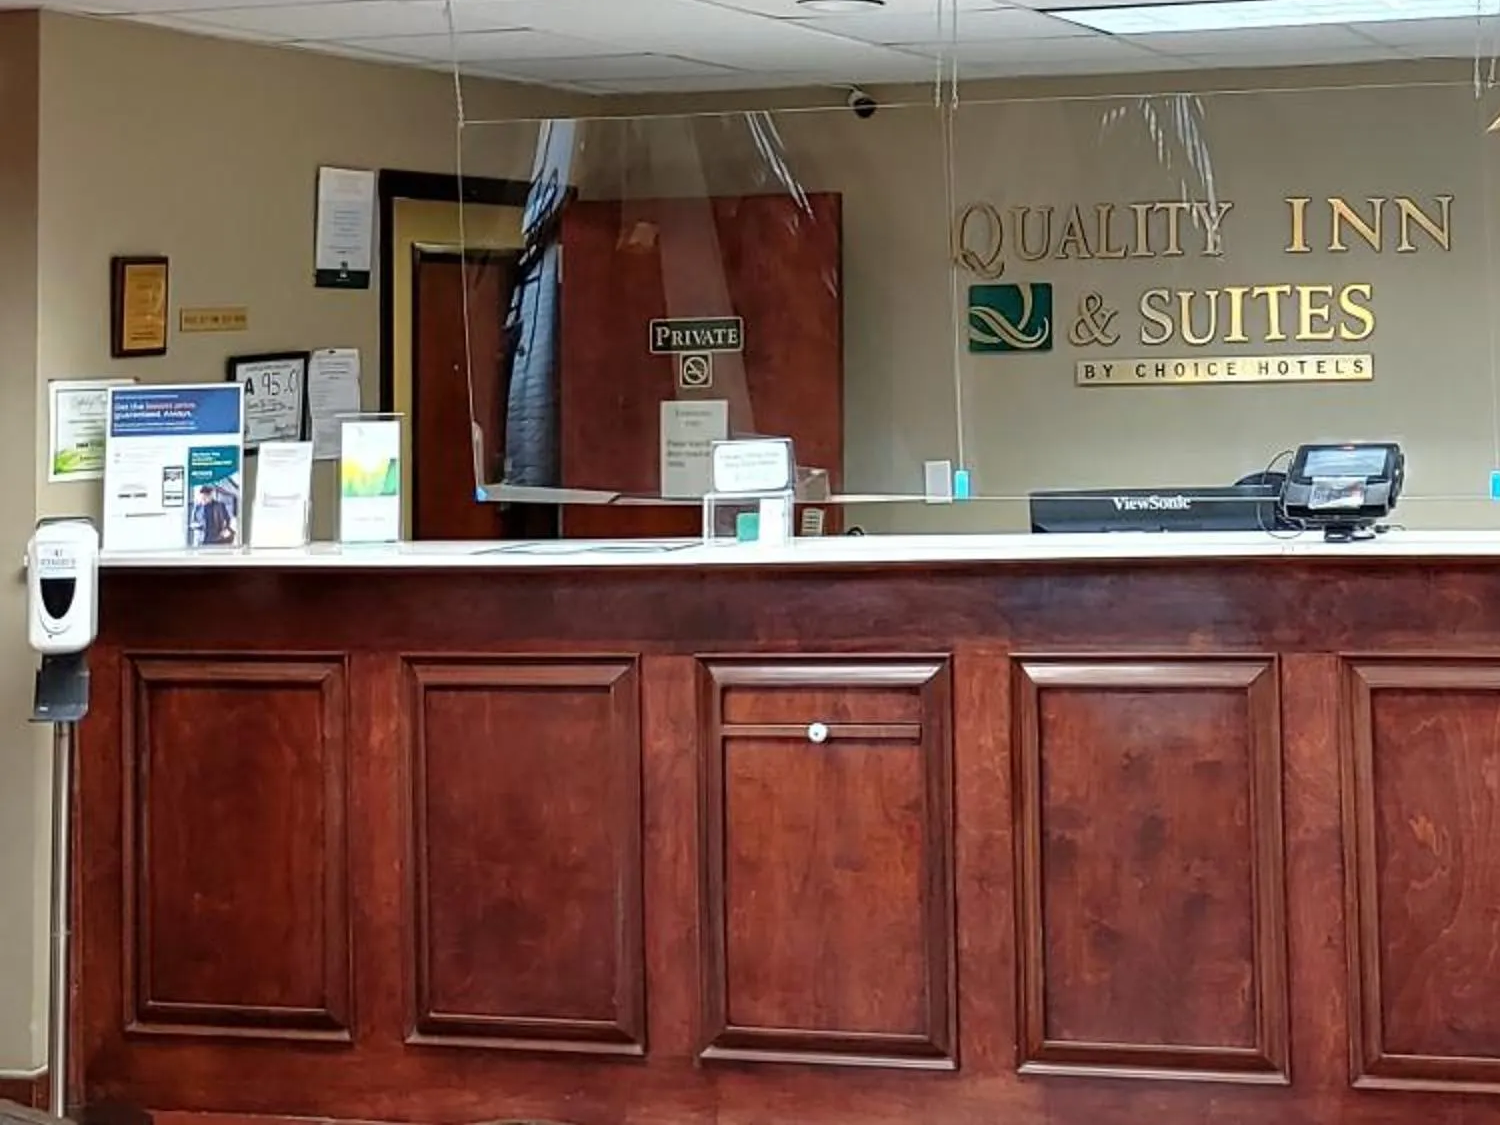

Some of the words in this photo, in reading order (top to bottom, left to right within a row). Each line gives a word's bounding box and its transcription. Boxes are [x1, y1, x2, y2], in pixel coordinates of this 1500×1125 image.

[951, 201, 1234, 279] QUALITY
[1284, 195, 1454, 254] INN
[1069, 290, 1120, 347] &
[1139, 283, 1376, 347] SUITES
[655, 325, 739, 347] PRIVATE
[1084, 364, 1114, 379] BY
[1134, 362, 1237, 378] CHOICE
[1257, 359, 1365, 376] HOTELS
[244, 376, 255, 396] A
[1112, 494, 1192, 511] ViewSonic
